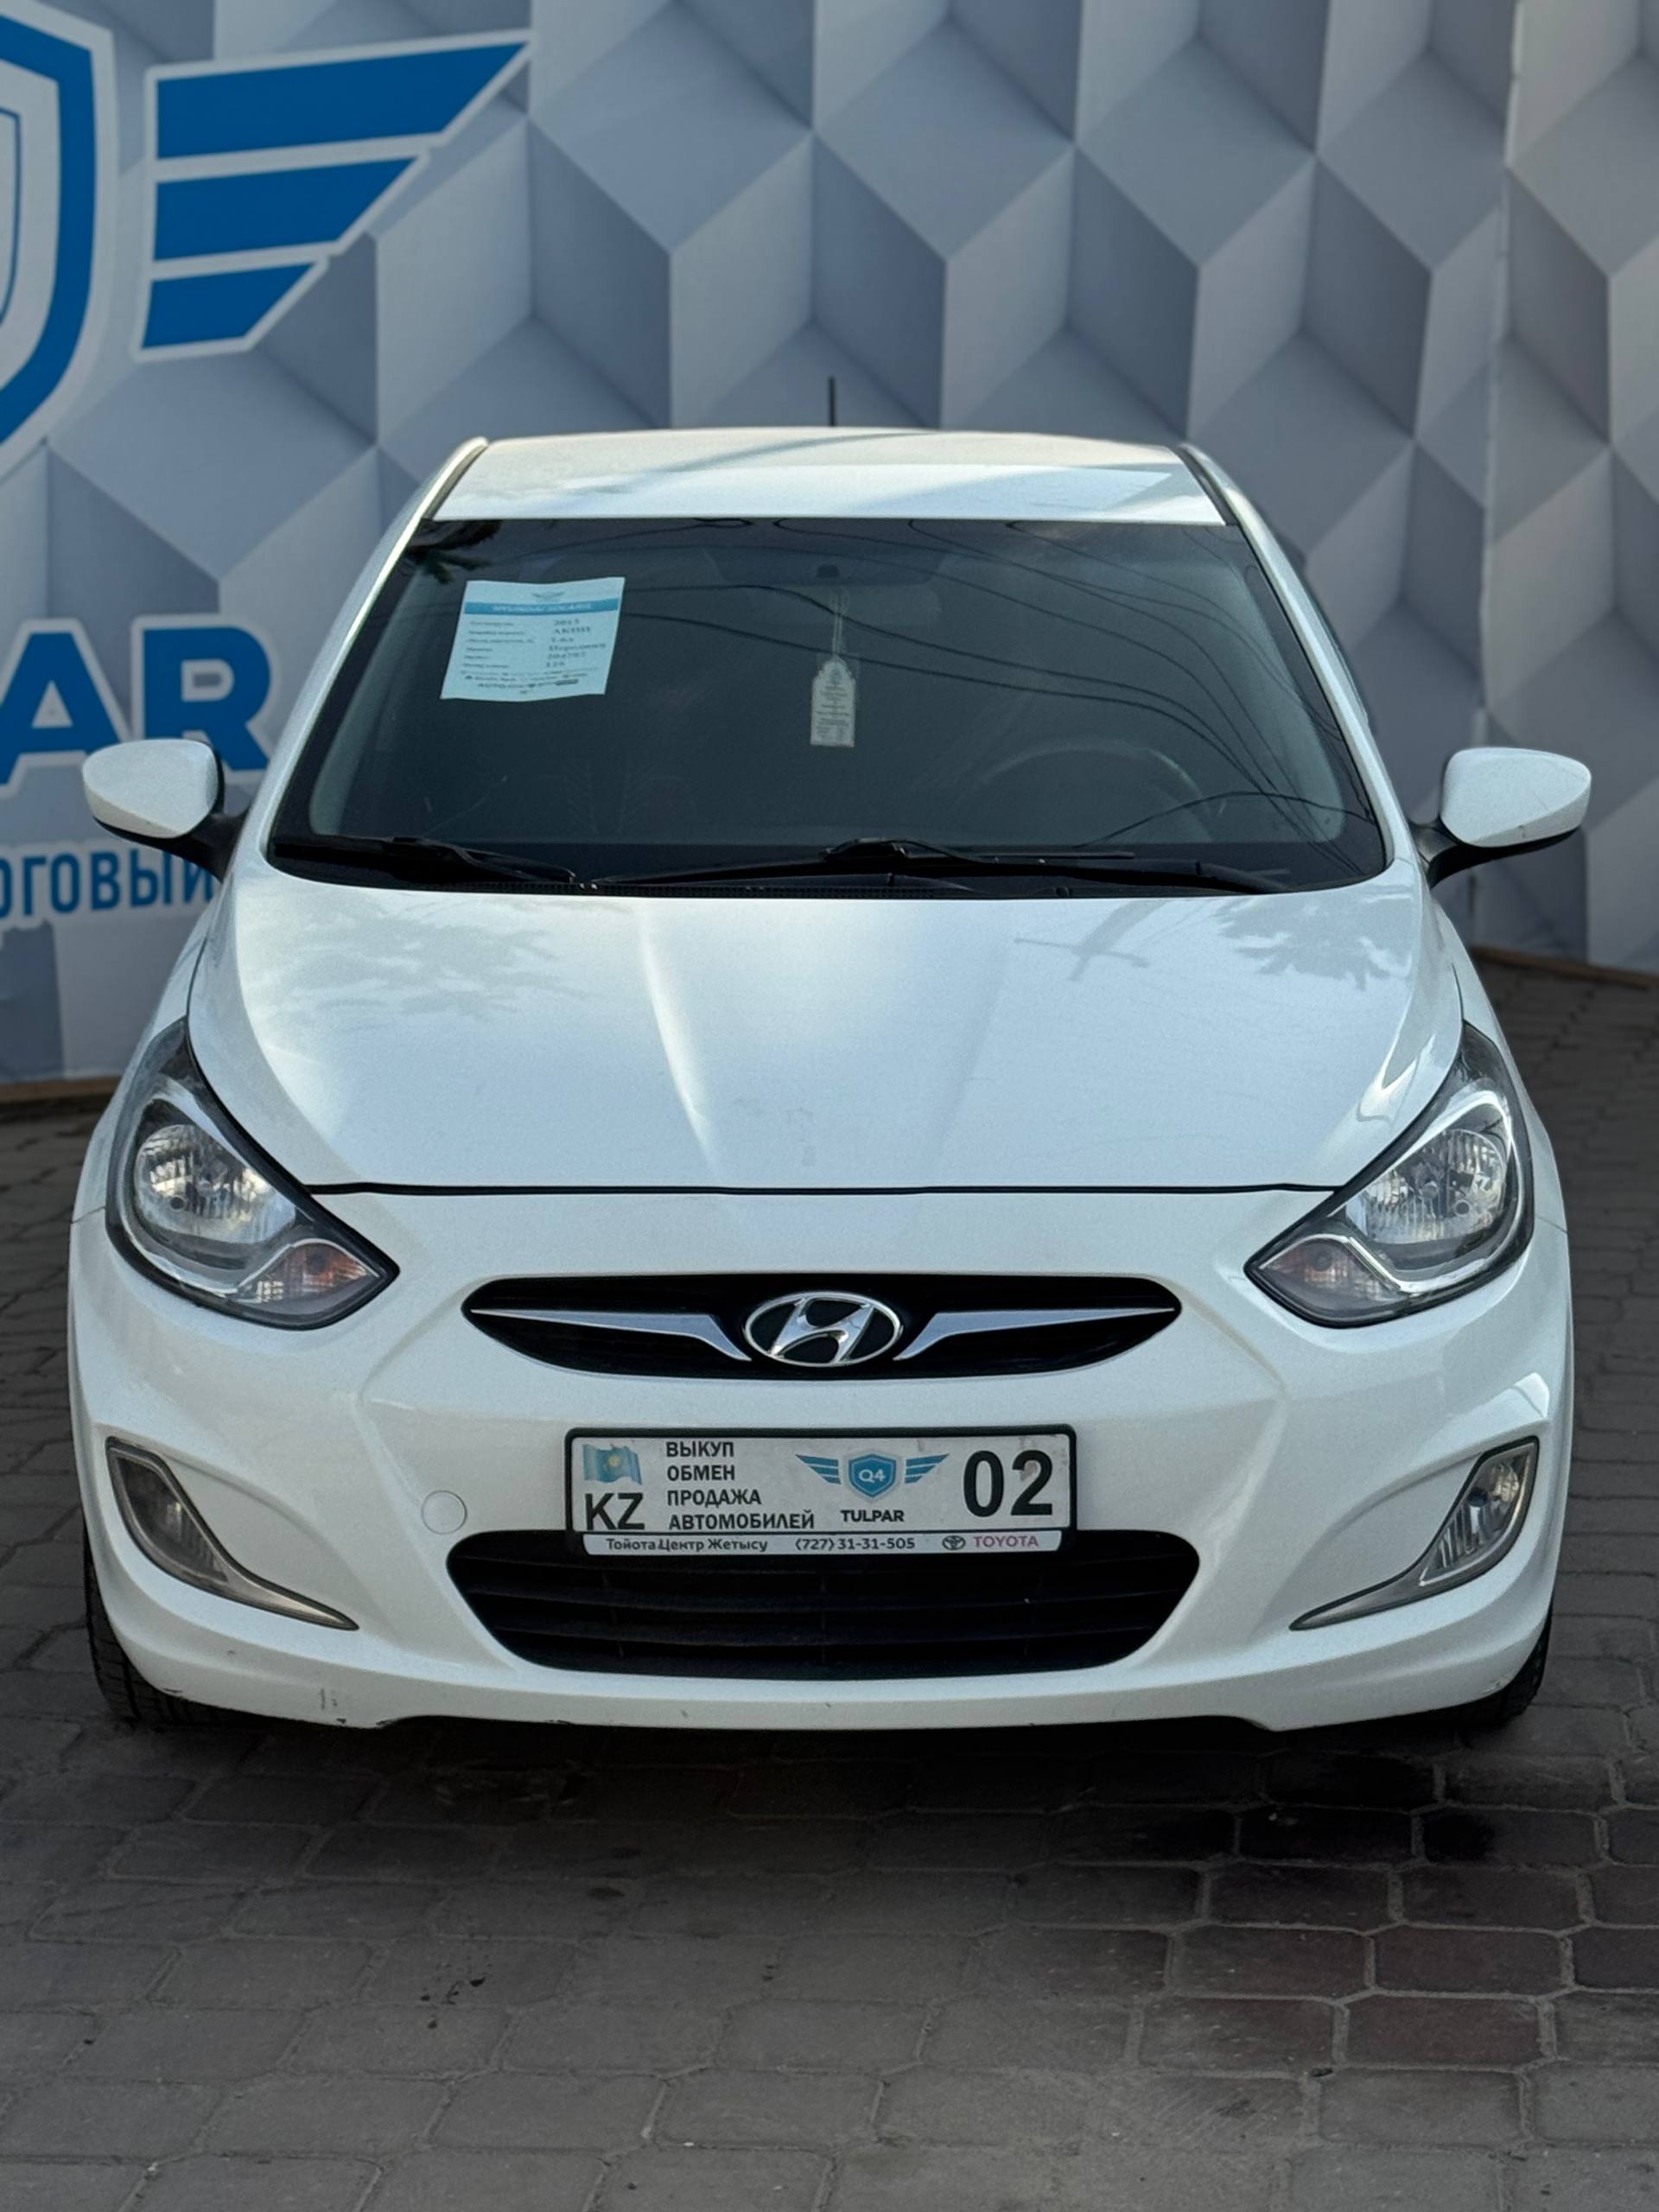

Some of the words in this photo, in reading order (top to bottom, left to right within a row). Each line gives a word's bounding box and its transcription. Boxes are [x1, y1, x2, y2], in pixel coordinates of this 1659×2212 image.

[666, 1441, 734, 1458] ВЫКУП
[666, 1465, 735, 1482] ОБМЕН
[963, 1450, 1053, 1517] 02
[667, 1489, 761, 1508] ПРОДАЖА
[585, 1492, 645, 1531] KZ
[668, 1510, 815, 1530] АВТОМОБИЛЕЙ
[840, 1510, 905, 1522] TULPAR
[707, 1538, 768, 1551] Жетысу
[838, 1537, 915, 1550] 31-31-505
[974, 1535, 1039, 1548] TOYOTA
